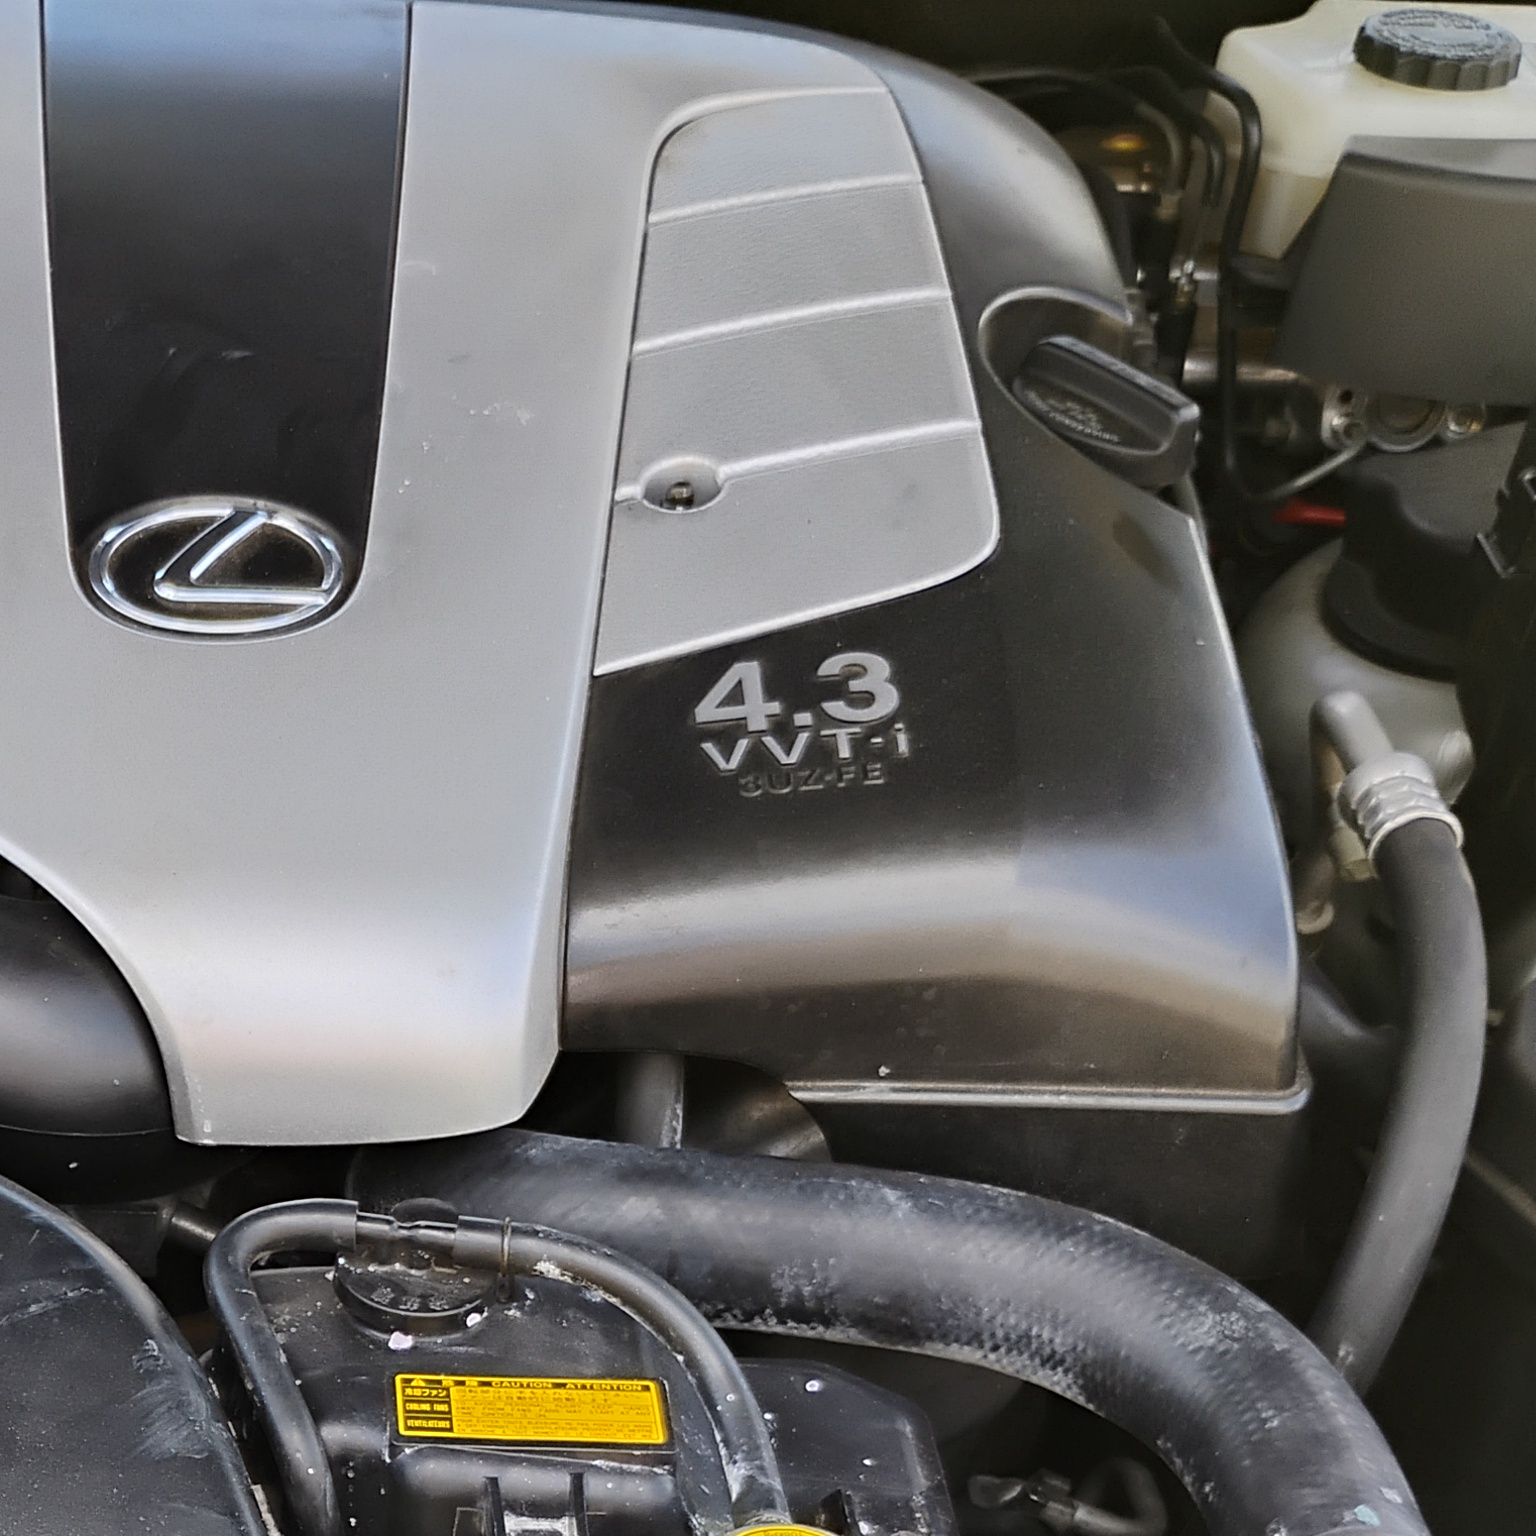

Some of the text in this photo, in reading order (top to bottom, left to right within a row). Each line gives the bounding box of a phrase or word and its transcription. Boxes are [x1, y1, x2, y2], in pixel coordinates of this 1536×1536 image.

[694, 651, 900, 733] 4.3
[700, 722, 909, 773] VVT-i
[565, 1382, 642, 1391] ATTENTION
